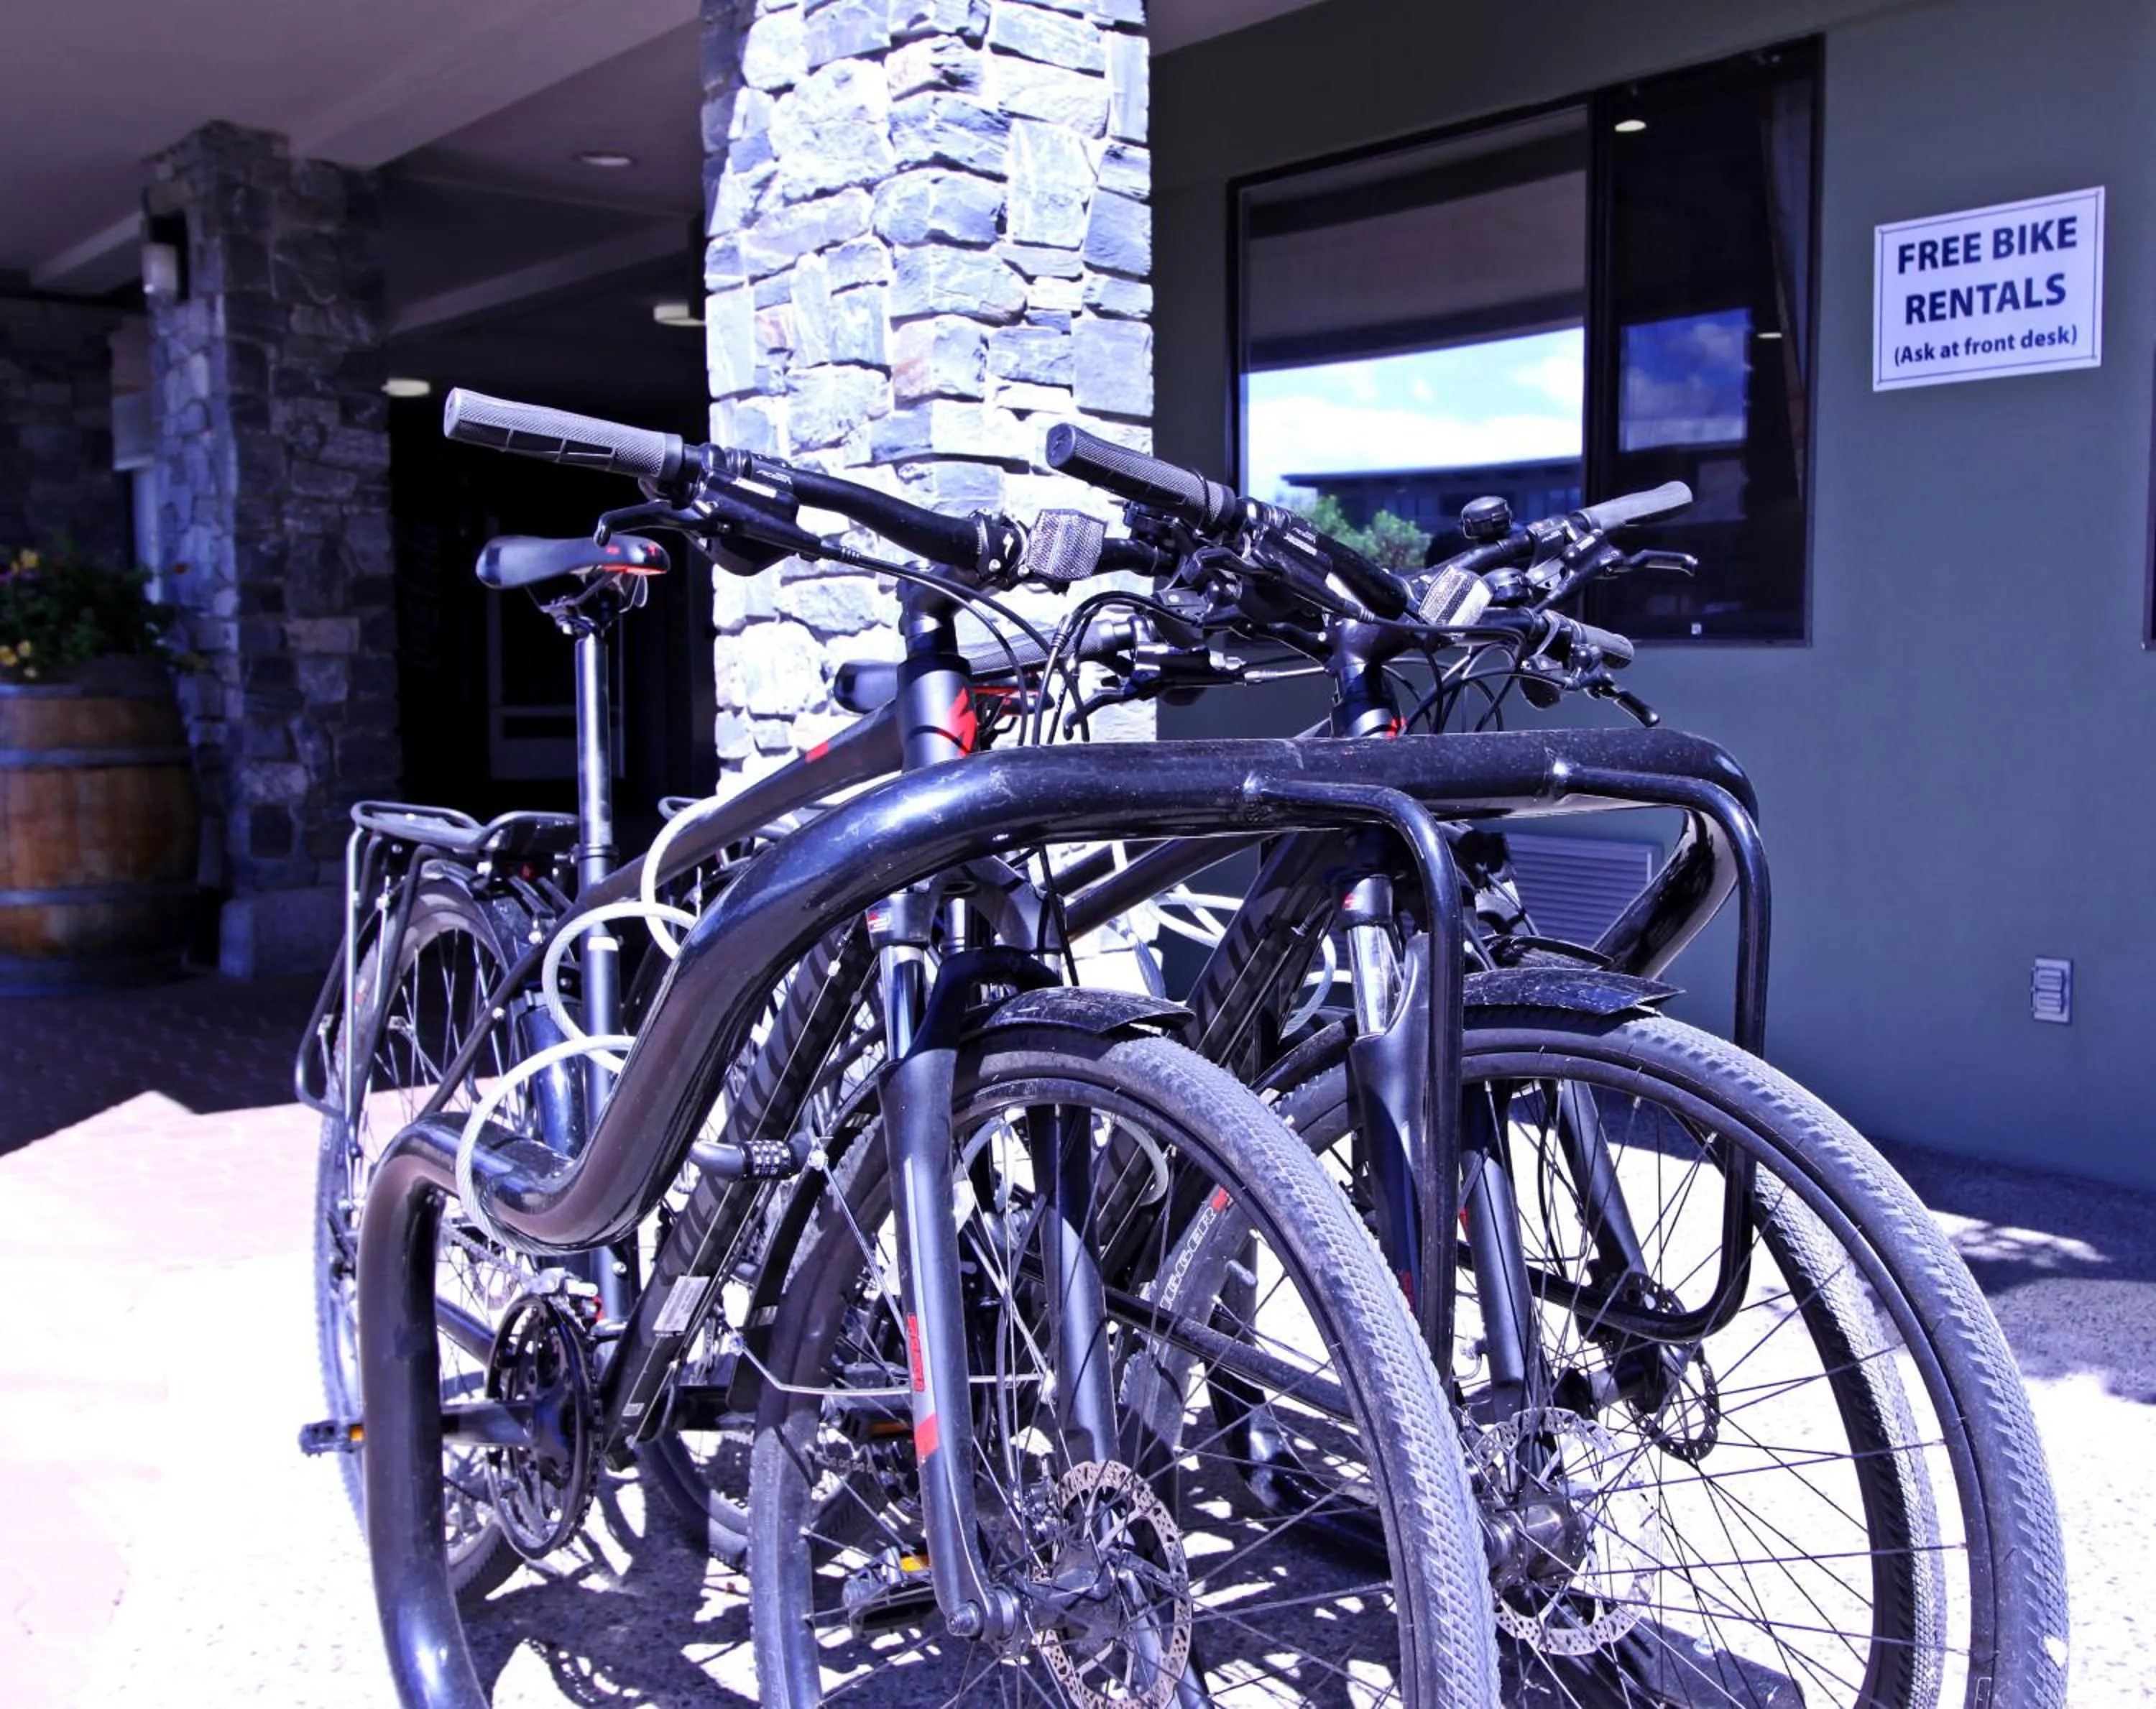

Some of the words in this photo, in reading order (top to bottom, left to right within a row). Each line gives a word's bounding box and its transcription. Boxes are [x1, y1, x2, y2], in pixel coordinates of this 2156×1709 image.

[1898, 232, 1981, 275] FREE
[1993, 216, 2078, 259] BIKE
[1905, 273, 2066, 325] RENTALS
[1894, 342, 1935, 367] (Ask
[1940, 341, 1959, 359] at
[1964, 336, 2014, 356] front
[2020, 324, 2078, 349] desk)
